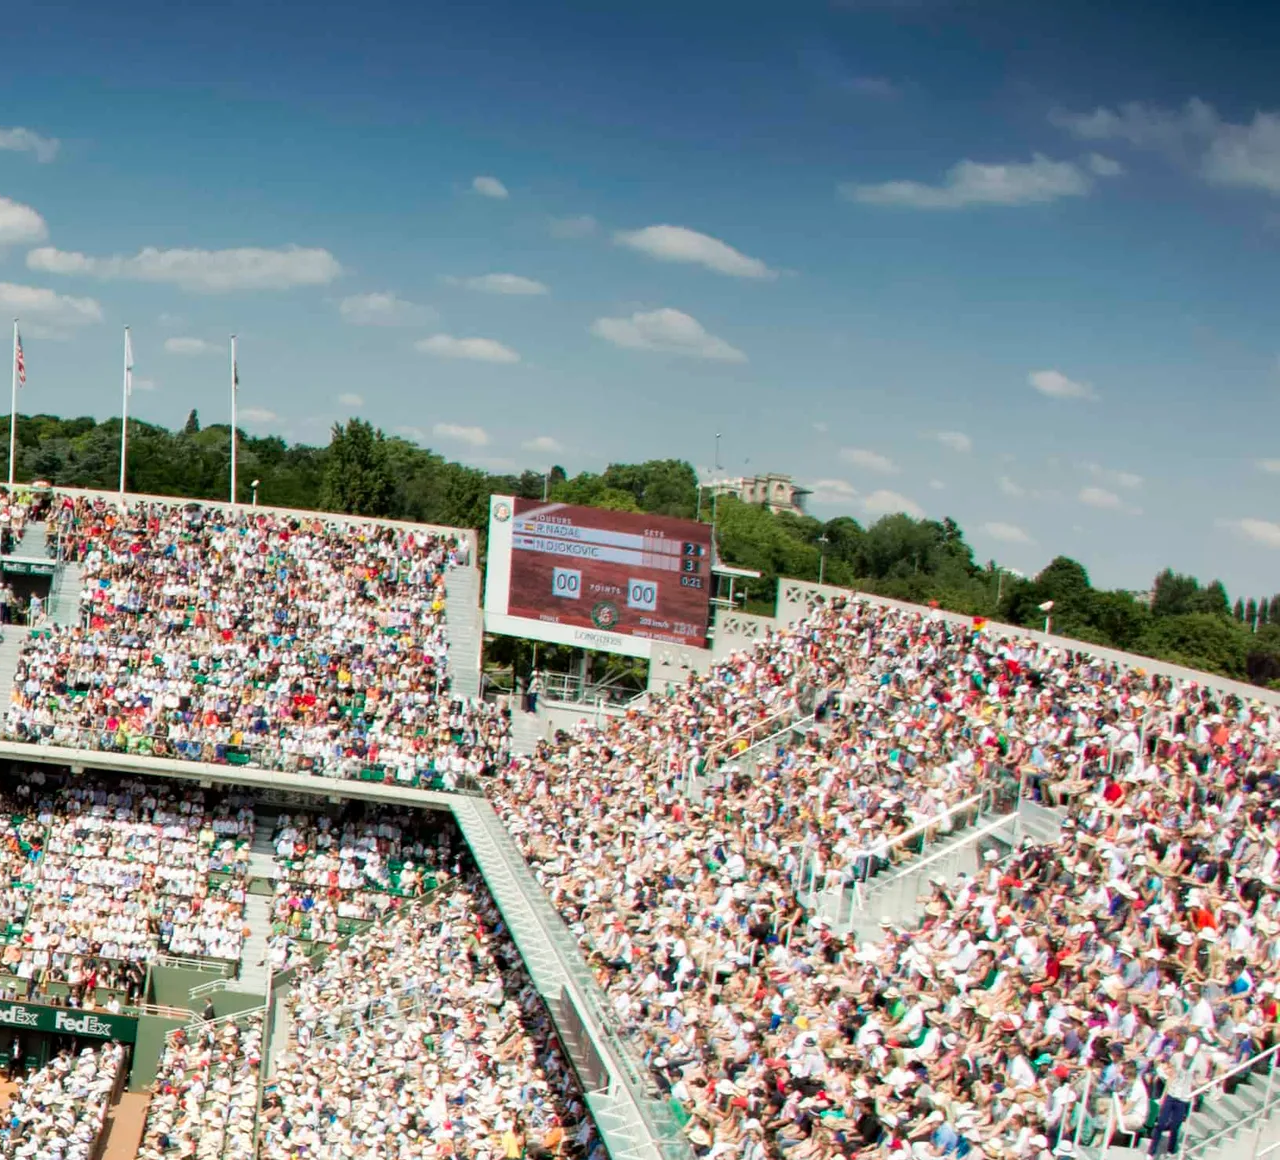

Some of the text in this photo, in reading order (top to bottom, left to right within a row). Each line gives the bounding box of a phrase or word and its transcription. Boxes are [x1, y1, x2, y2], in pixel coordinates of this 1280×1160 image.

[687, 544, 694, 555] 2
[686, 560, 693, 571] 3
[557, 574, 577, 591] 00
[589, 584, 621, 595] POINTS
[632, 585, 653, 603] 00
[673, 622, 697, 637] IBM
[55, 1011, 112, 1036] FedEx
